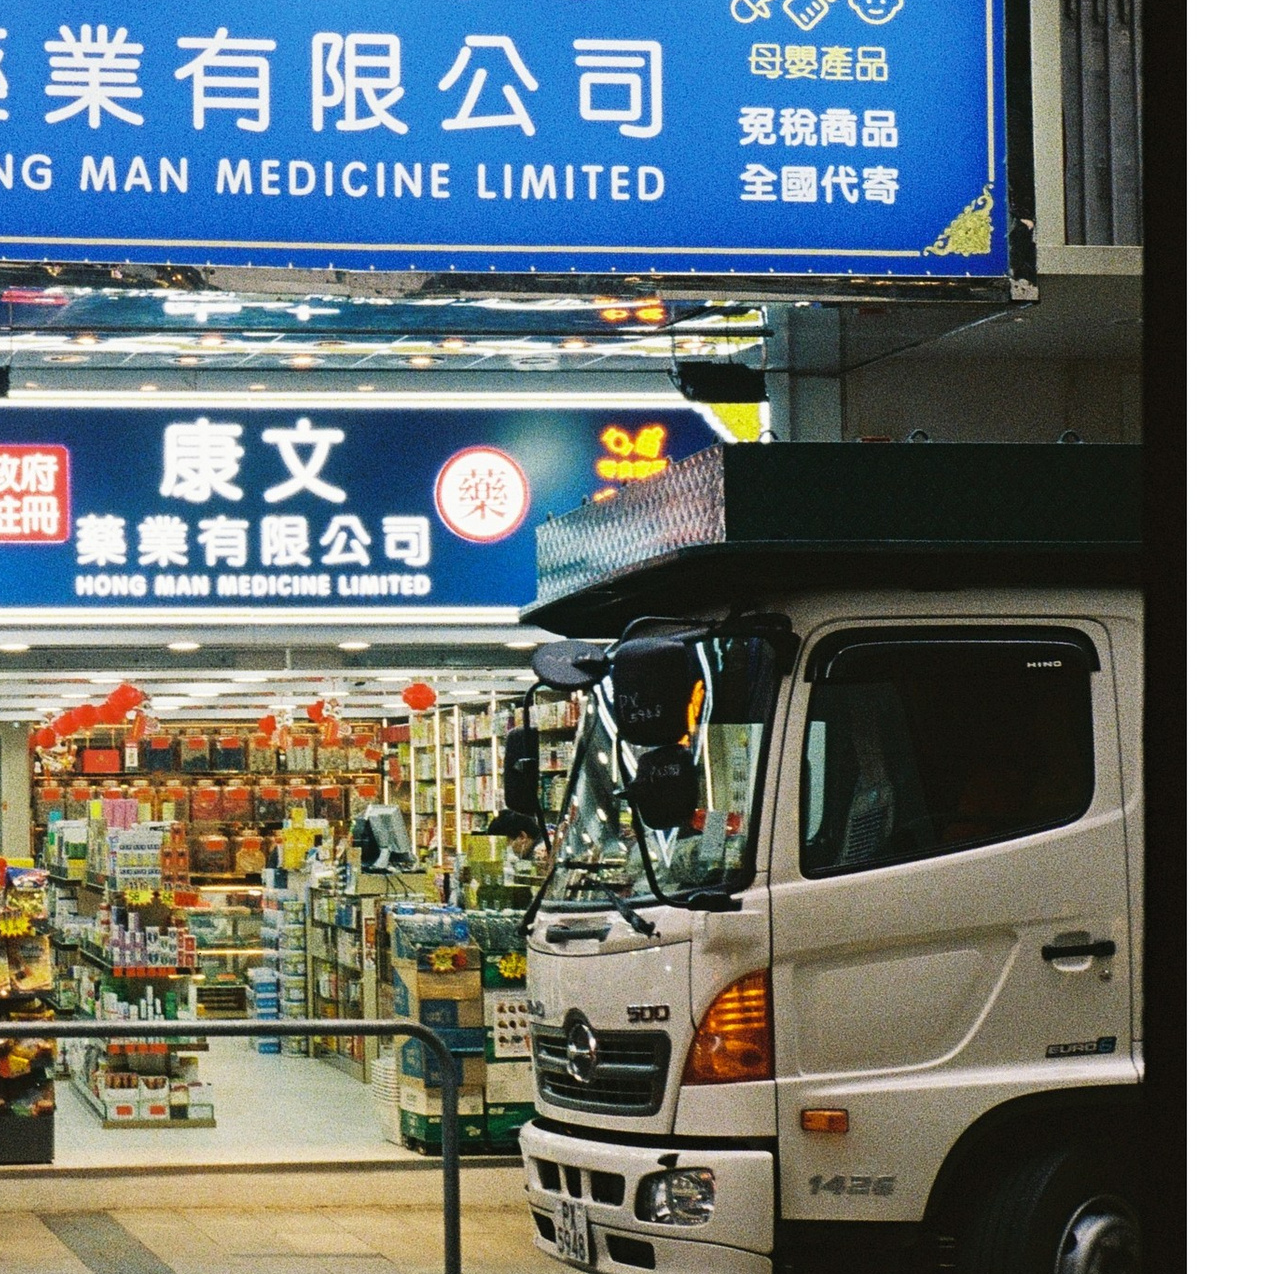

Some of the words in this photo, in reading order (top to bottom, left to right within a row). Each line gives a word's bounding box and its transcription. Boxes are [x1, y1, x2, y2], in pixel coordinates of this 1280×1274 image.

[748, 43, 889, 82] 母嬰產品
[80, 156, 189, 194] MAN
[217, 159, 451, 199] MEDICINE
[478, 164, 666, 202] LIMITED
[740, 164, 900, 205] 全國代寄
[159, 417, 348, 505] 康文
[457, 470, 509, 521] 藥
[74, 514, 432, 569] 藥業有限公司
[75, 574, 147, 597] HONG
[154, 574, 211, 597] MAN
[217, 574, 331, 598] MEDICINE
[337, 574, 433, 597] LIMITED
[1026, 660, 1062, 668] HINO
[626, 1004, 670, 1023] 500
